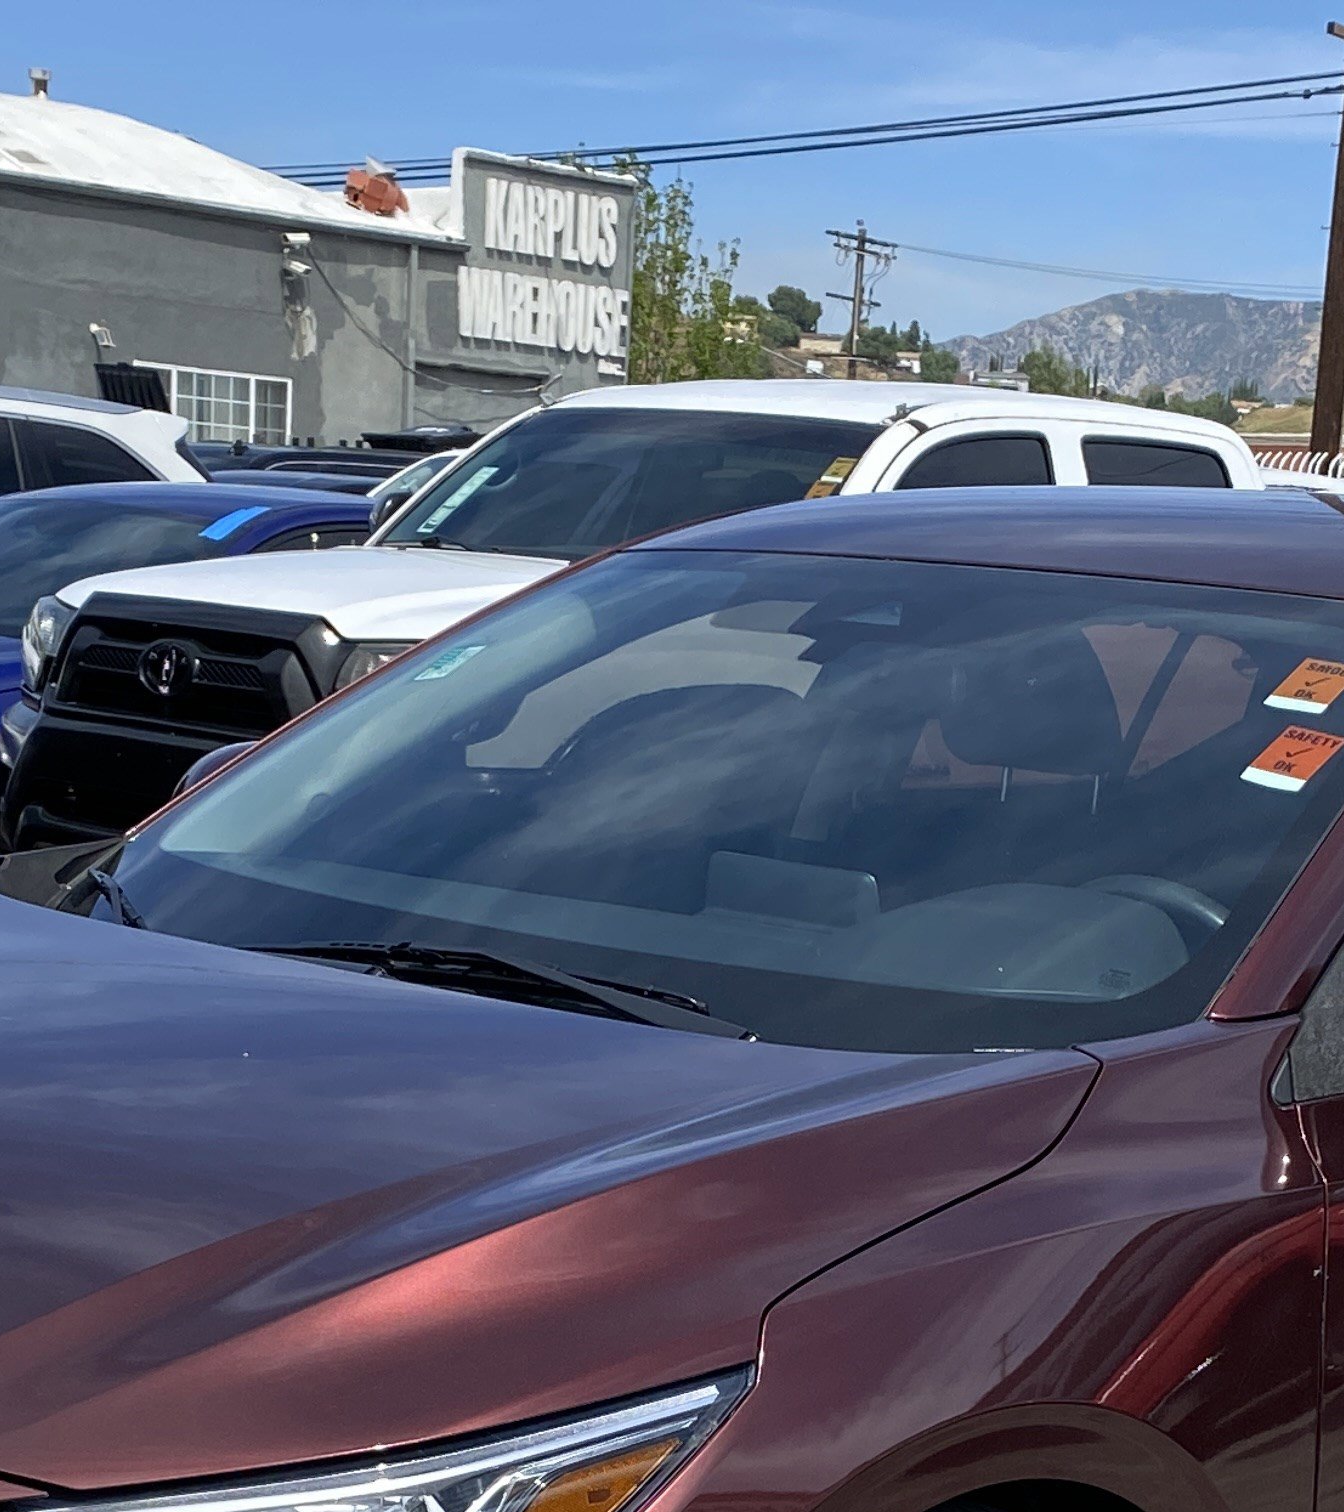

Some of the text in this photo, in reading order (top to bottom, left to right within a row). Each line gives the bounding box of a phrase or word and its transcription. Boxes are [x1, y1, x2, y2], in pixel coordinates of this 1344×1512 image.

[485, 178, 618, 267] KARPLUS
[458, 266, 629, 357] WAREHOUSE
[1294, 688, 1316, 700] OK
[1284, 729, 1342, 749] SAFETY
[1274, 760, 1297, 773] OK
